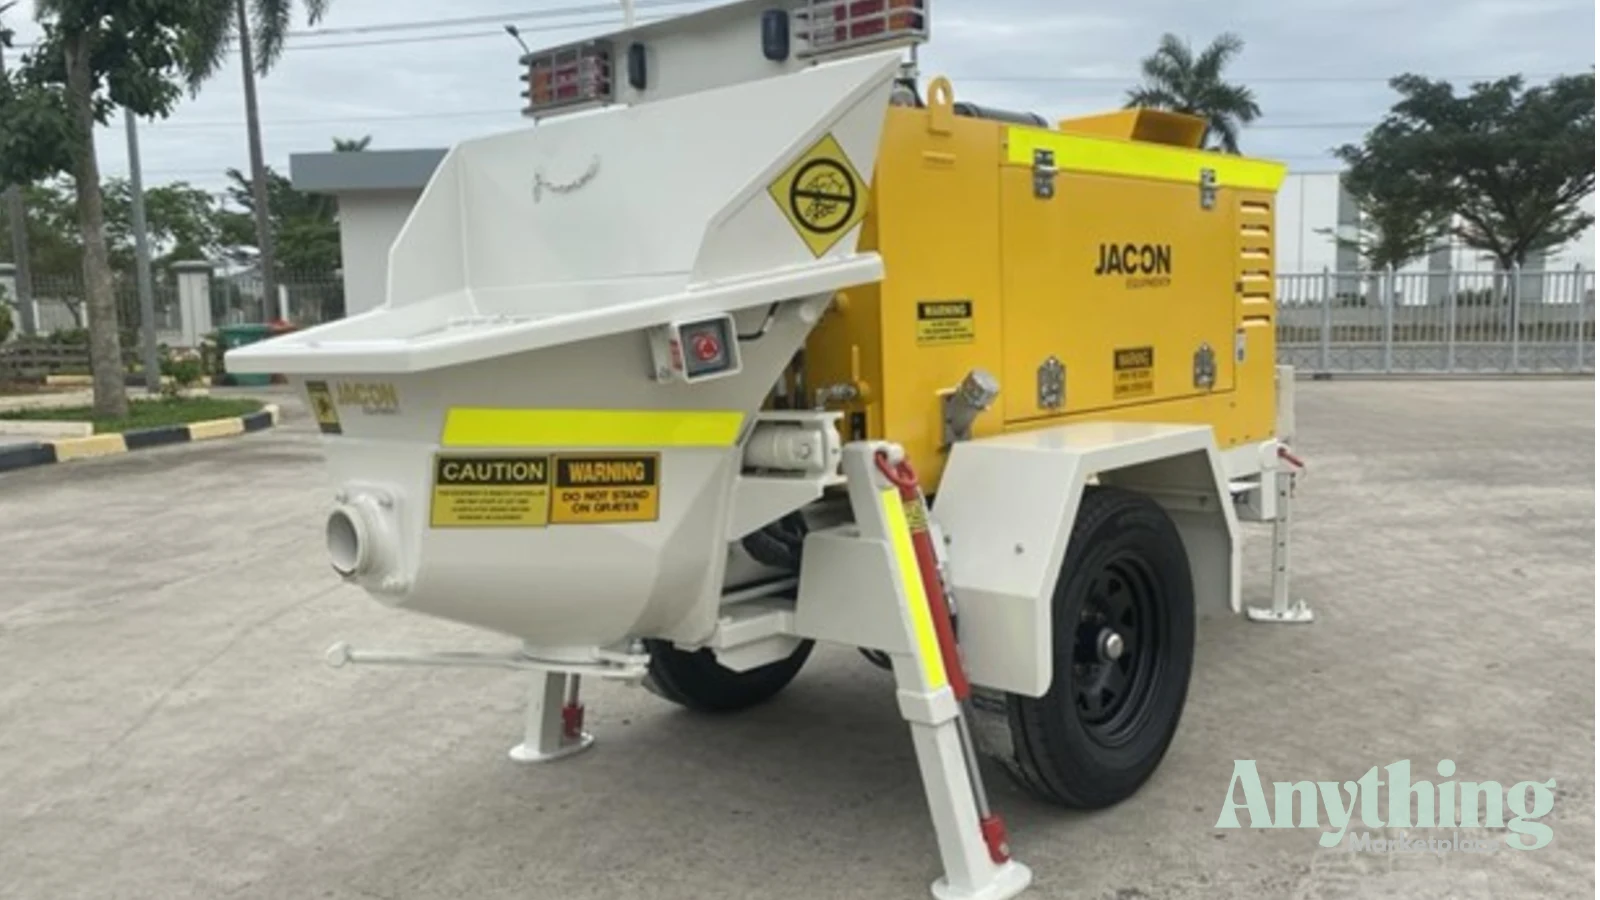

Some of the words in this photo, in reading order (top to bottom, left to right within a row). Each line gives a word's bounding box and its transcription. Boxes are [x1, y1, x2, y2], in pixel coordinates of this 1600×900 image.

[1094, 243, 1171, 275] JACON
[336, 382, 399, 407] JACON
[442, 462, 544, 481] CAUTION
[568, 461, 645, 483] WARNING
[562, 492, 581, 502] DO
[583, 490, 608, 501] NOT
[611, 489, 650, 501] STAND
[571, 502, 590, 514] ON
